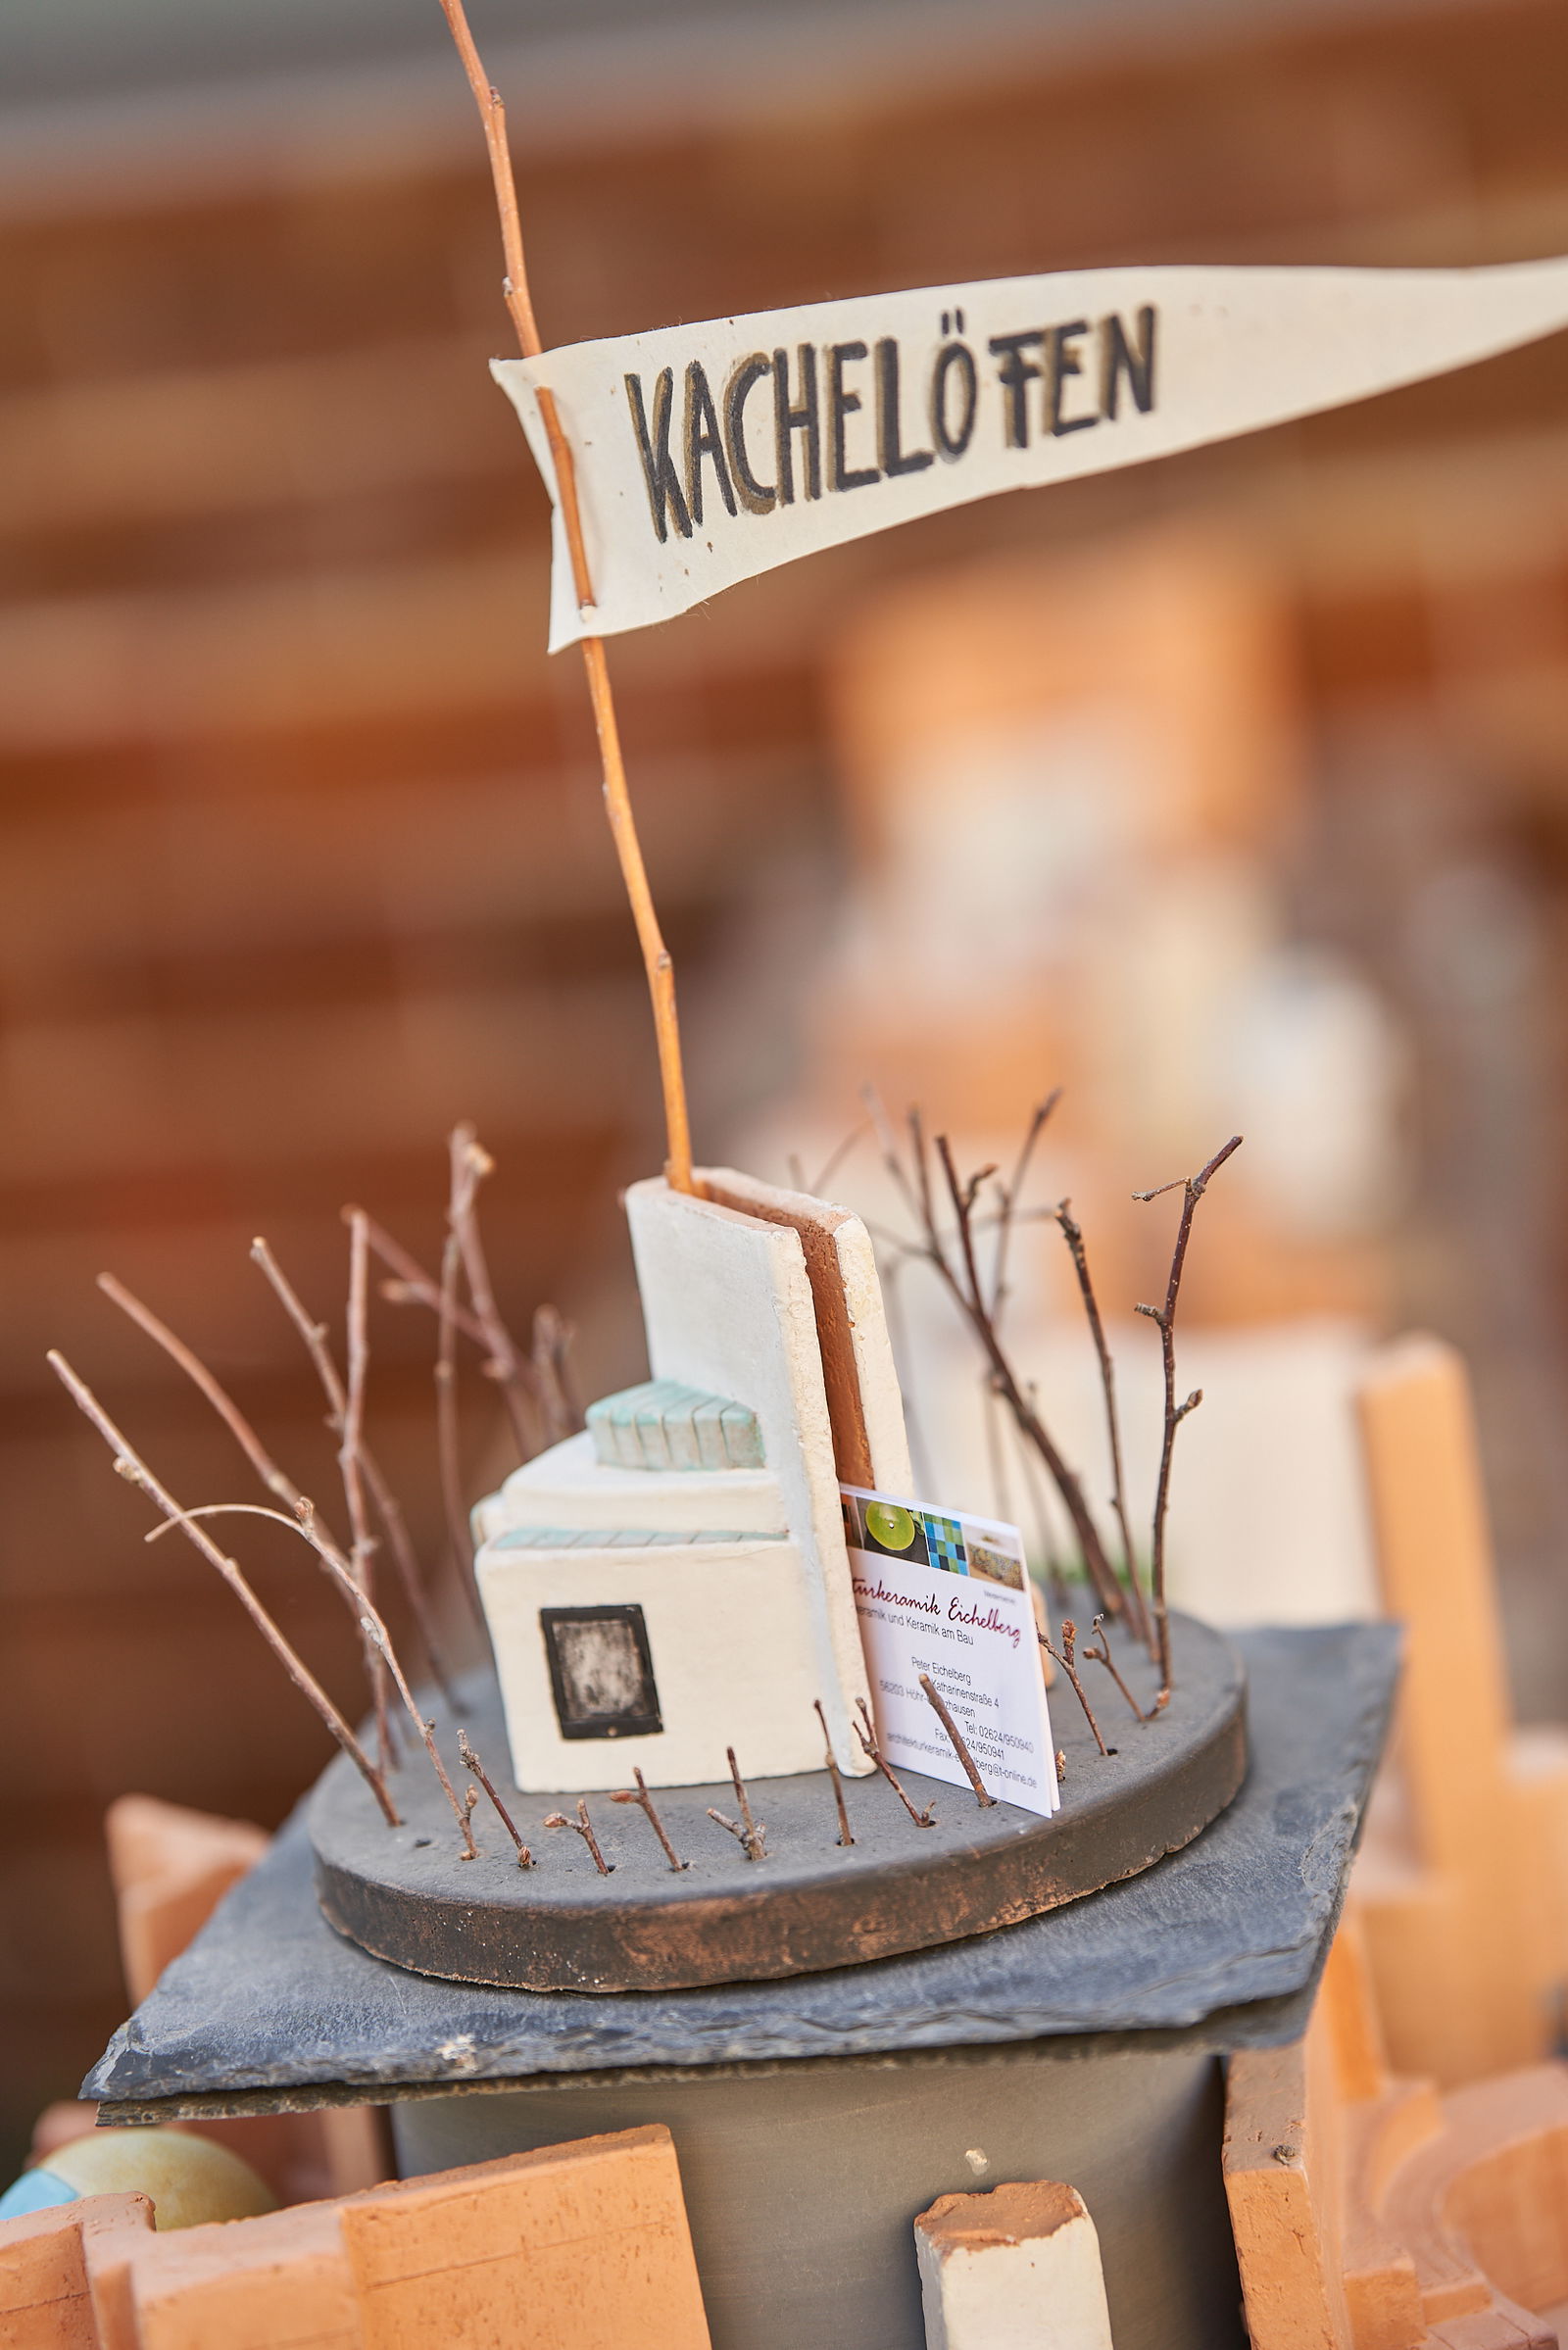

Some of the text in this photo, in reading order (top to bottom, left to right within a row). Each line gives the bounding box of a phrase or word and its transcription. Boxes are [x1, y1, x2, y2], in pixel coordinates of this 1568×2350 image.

[623, 307, 1154, 543] KACHELÖFEN
[888, 1613, 904, 1626] und
[906, 1616, 940, 1636] Keramik
[942, 1628, 956, 1640] am
[956, 1629, 974, 1645] Bau
[949, 1596, 1020, 1648] Eichelberg
[911, 1656, 971, 1686] Peter Eichelberg
[995, 1697, 1000, 1708] 4
